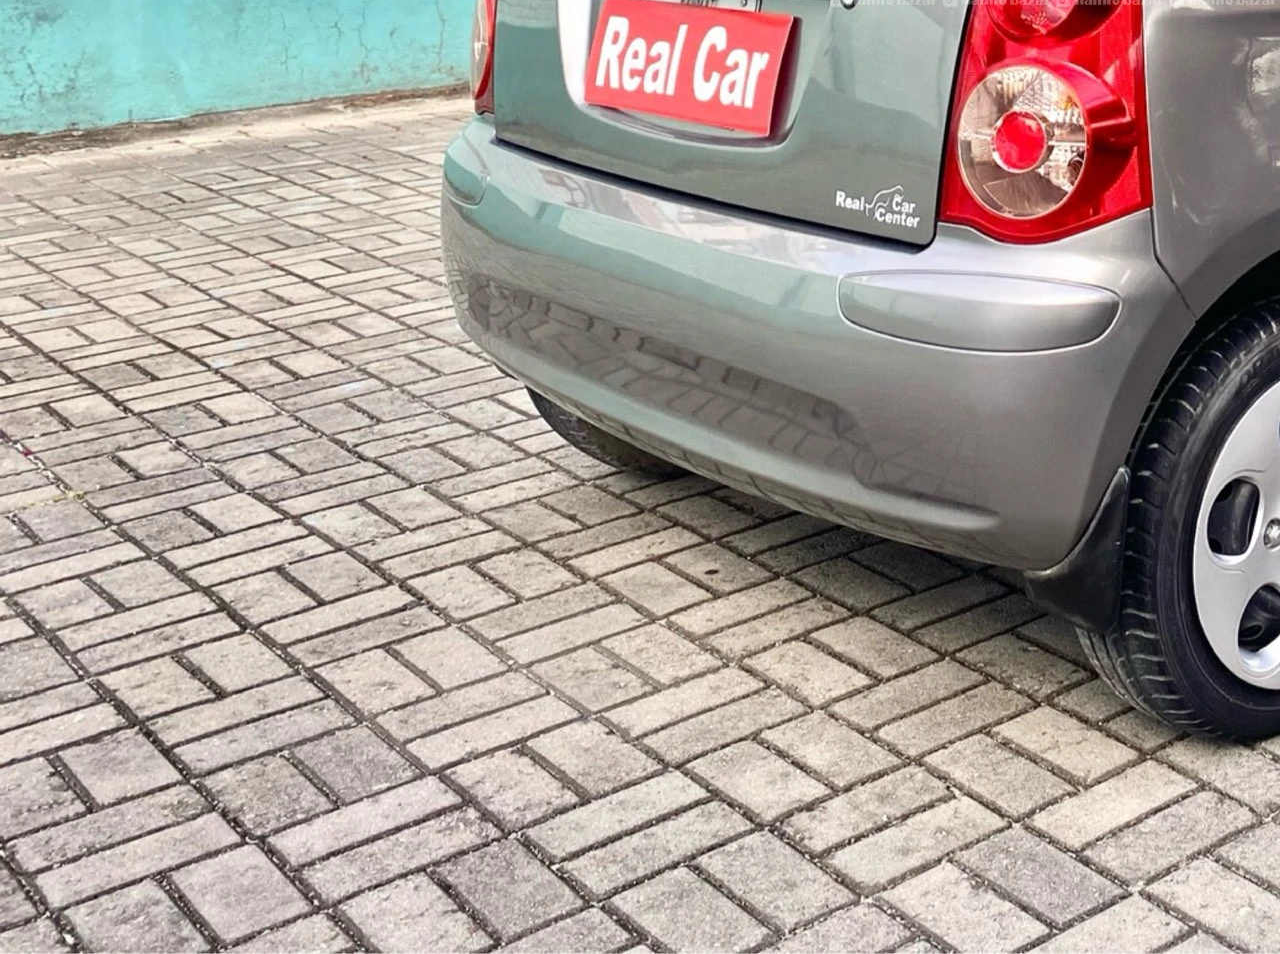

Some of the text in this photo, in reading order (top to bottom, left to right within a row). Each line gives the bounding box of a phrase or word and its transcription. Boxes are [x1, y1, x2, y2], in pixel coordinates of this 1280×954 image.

[595, 15, 769, 110] Real Car
[835, 190, 916, 213] Real Car
[876, 208, 920, 228] Center
